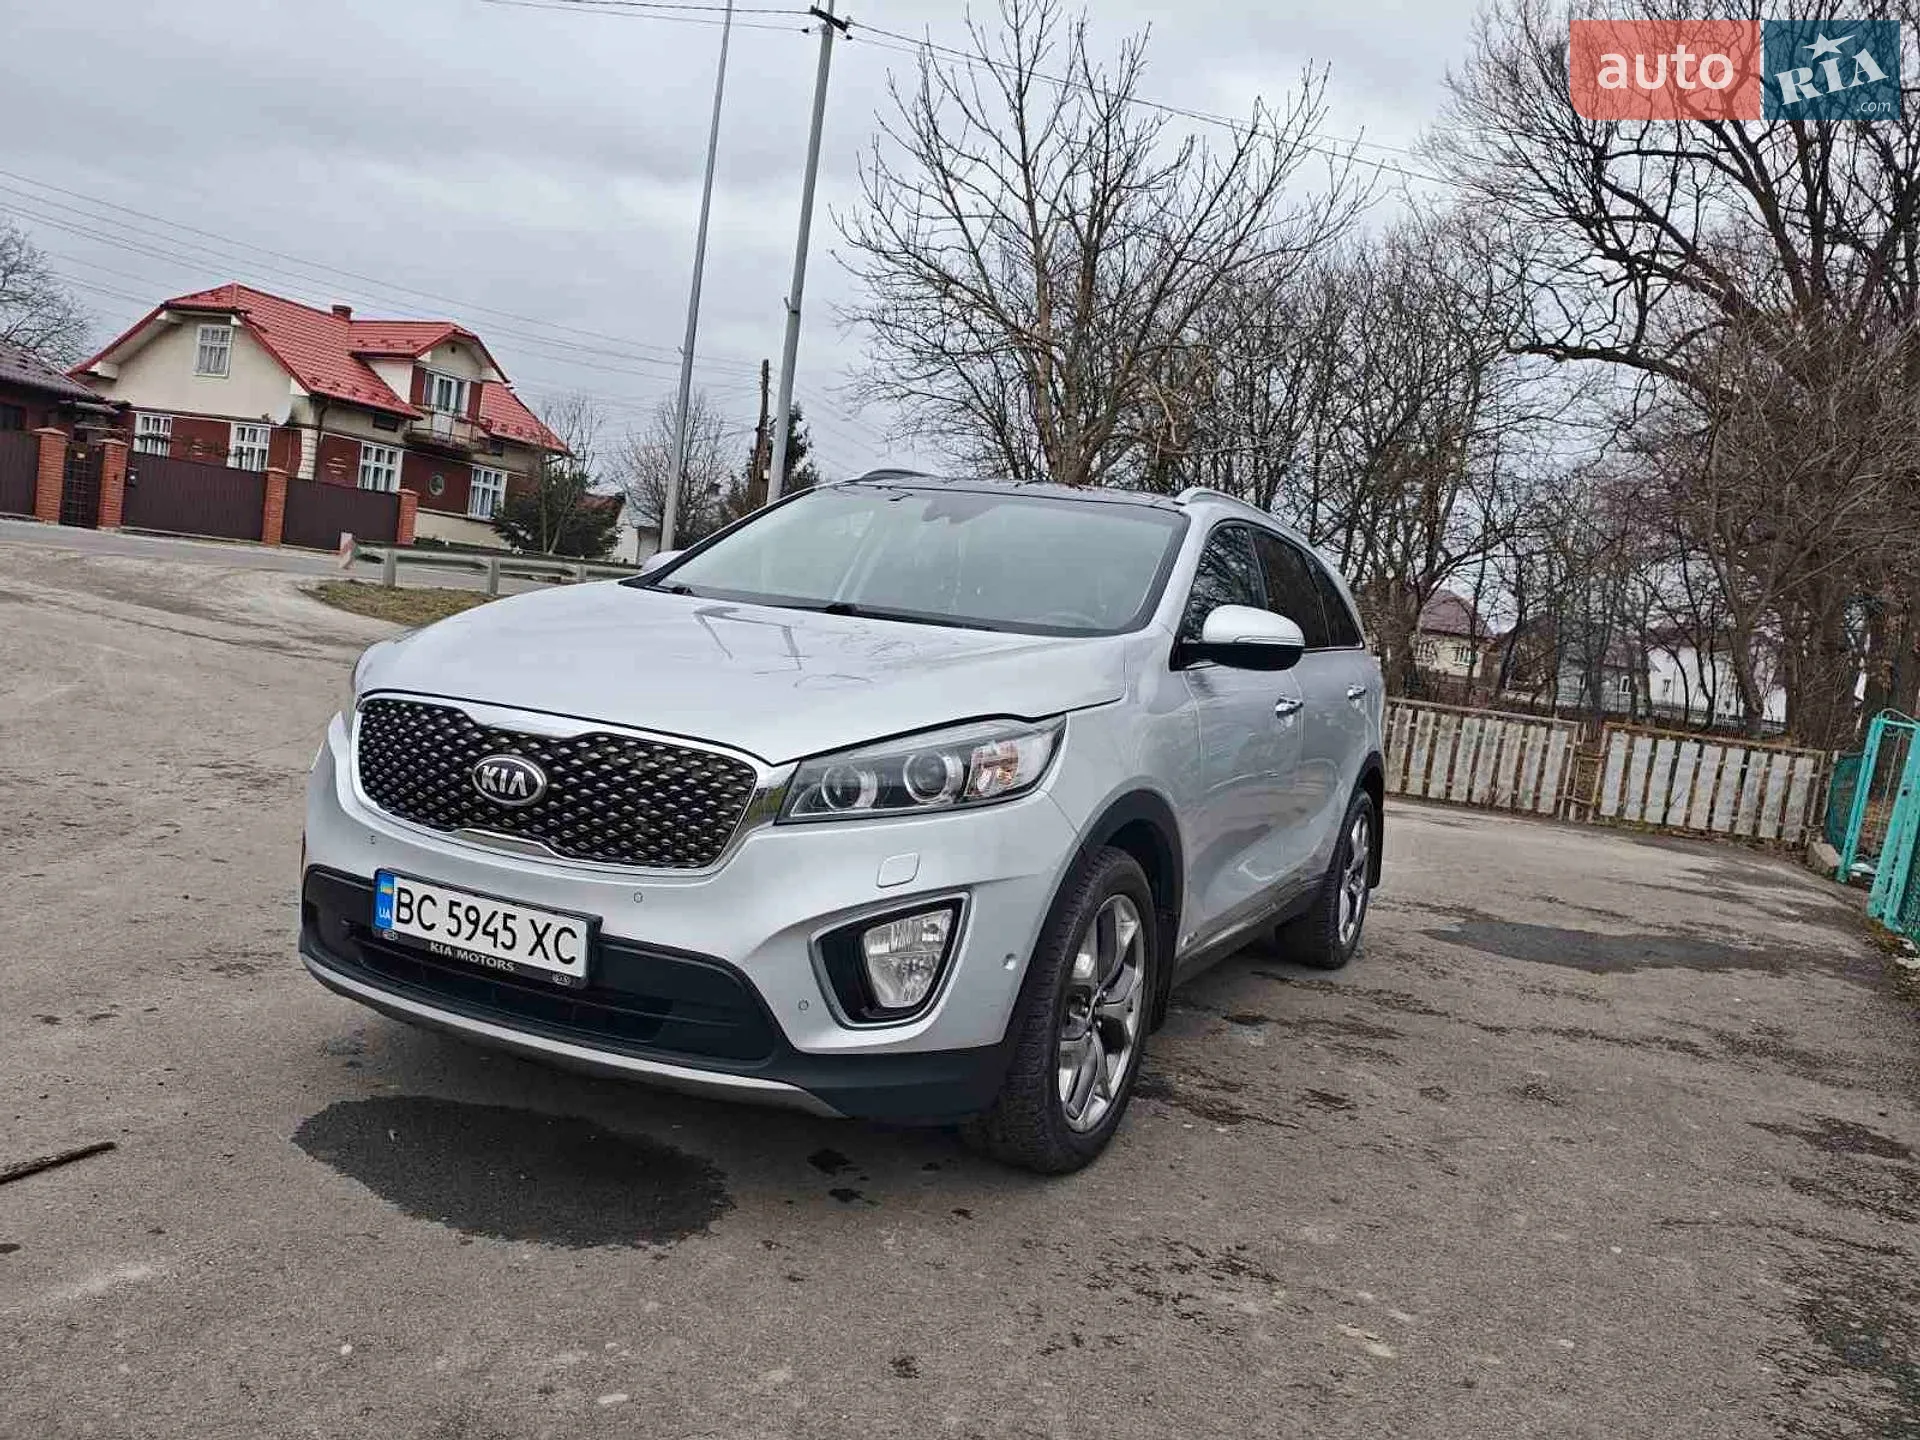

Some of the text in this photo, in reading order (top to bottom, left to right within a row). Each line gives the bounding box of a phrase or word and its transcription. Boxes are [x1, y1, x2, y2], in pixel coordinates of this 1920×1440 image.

[481, 765, 528, 797] KIA
[379, 906, 392, 920] UA
[396, 886, 578, 965] BC 5945 XC
[430, 942, 515, 972] KIA MOTORS
